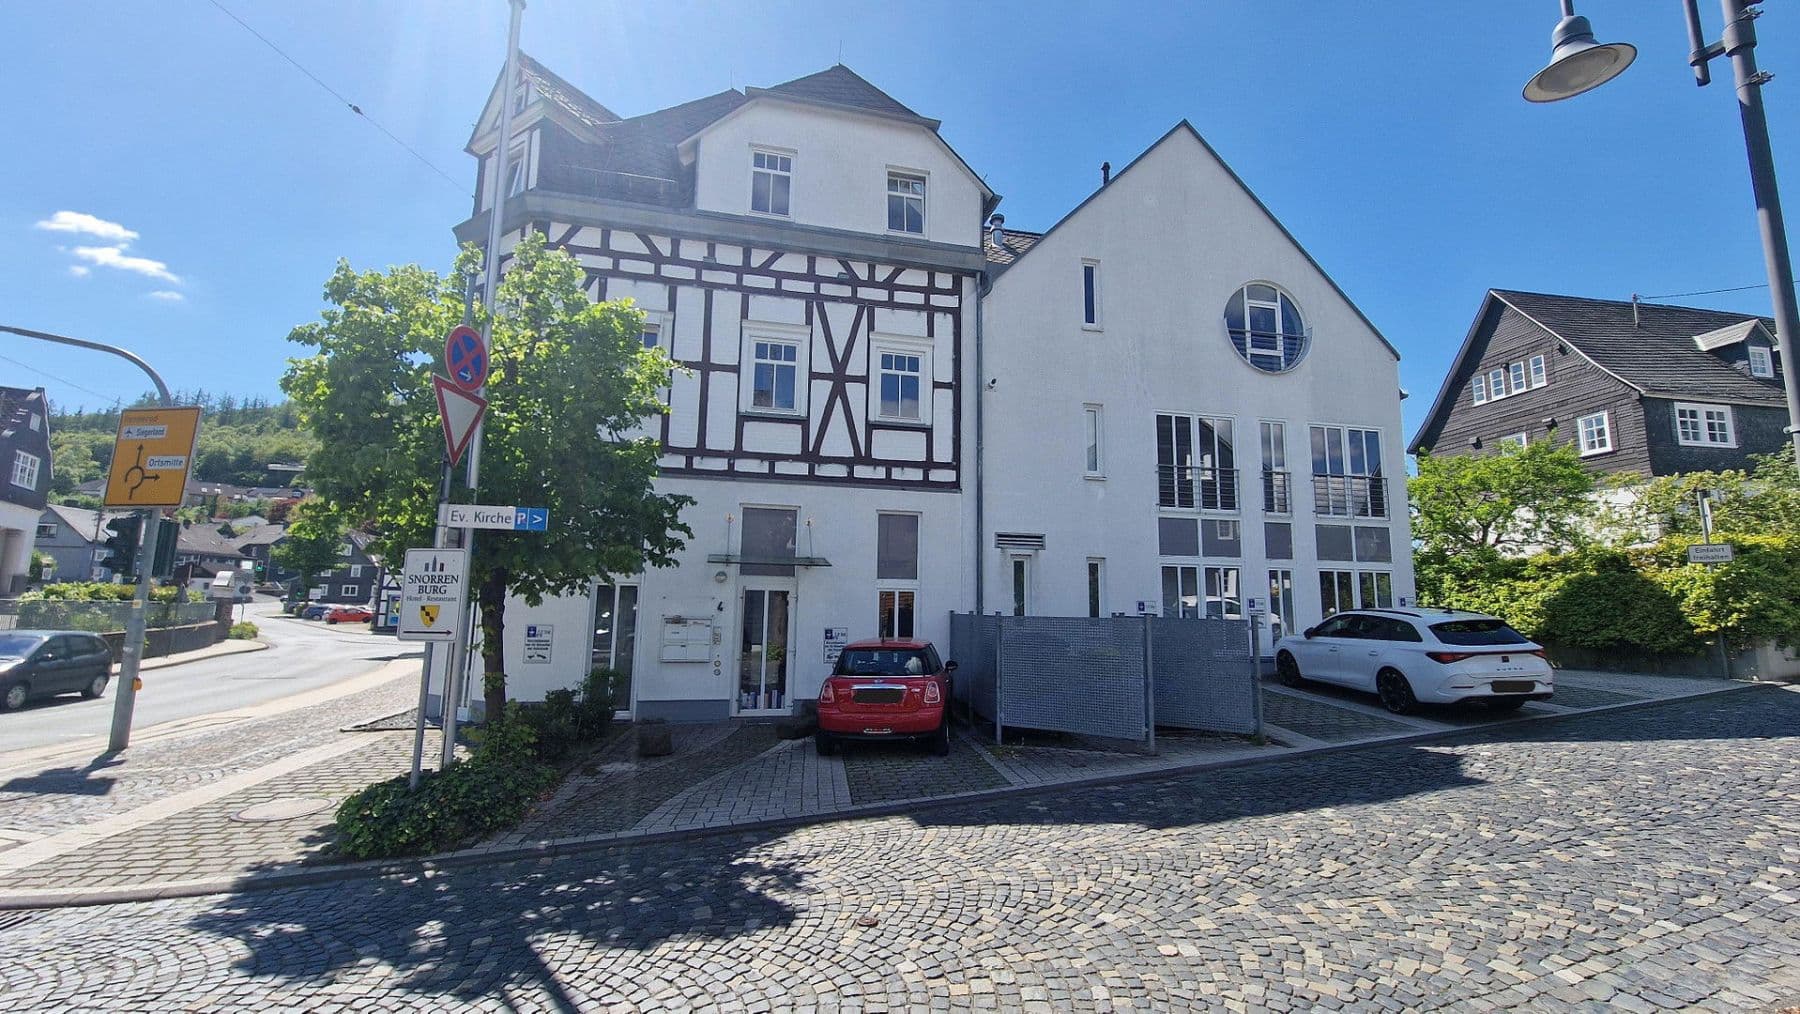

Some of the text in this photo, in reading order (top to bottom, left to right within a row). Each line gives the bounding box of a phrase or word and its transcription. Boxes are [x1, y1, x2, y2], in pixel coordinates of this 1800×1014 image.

[148, 458, 184, 467] Ortsmitte
[450, 510, 469, 522] Ev.
[473, 511, 512, 524] Kirche
[408, 574, 459, 585] SNORREN
[418, 585, 448, 595] BURG
